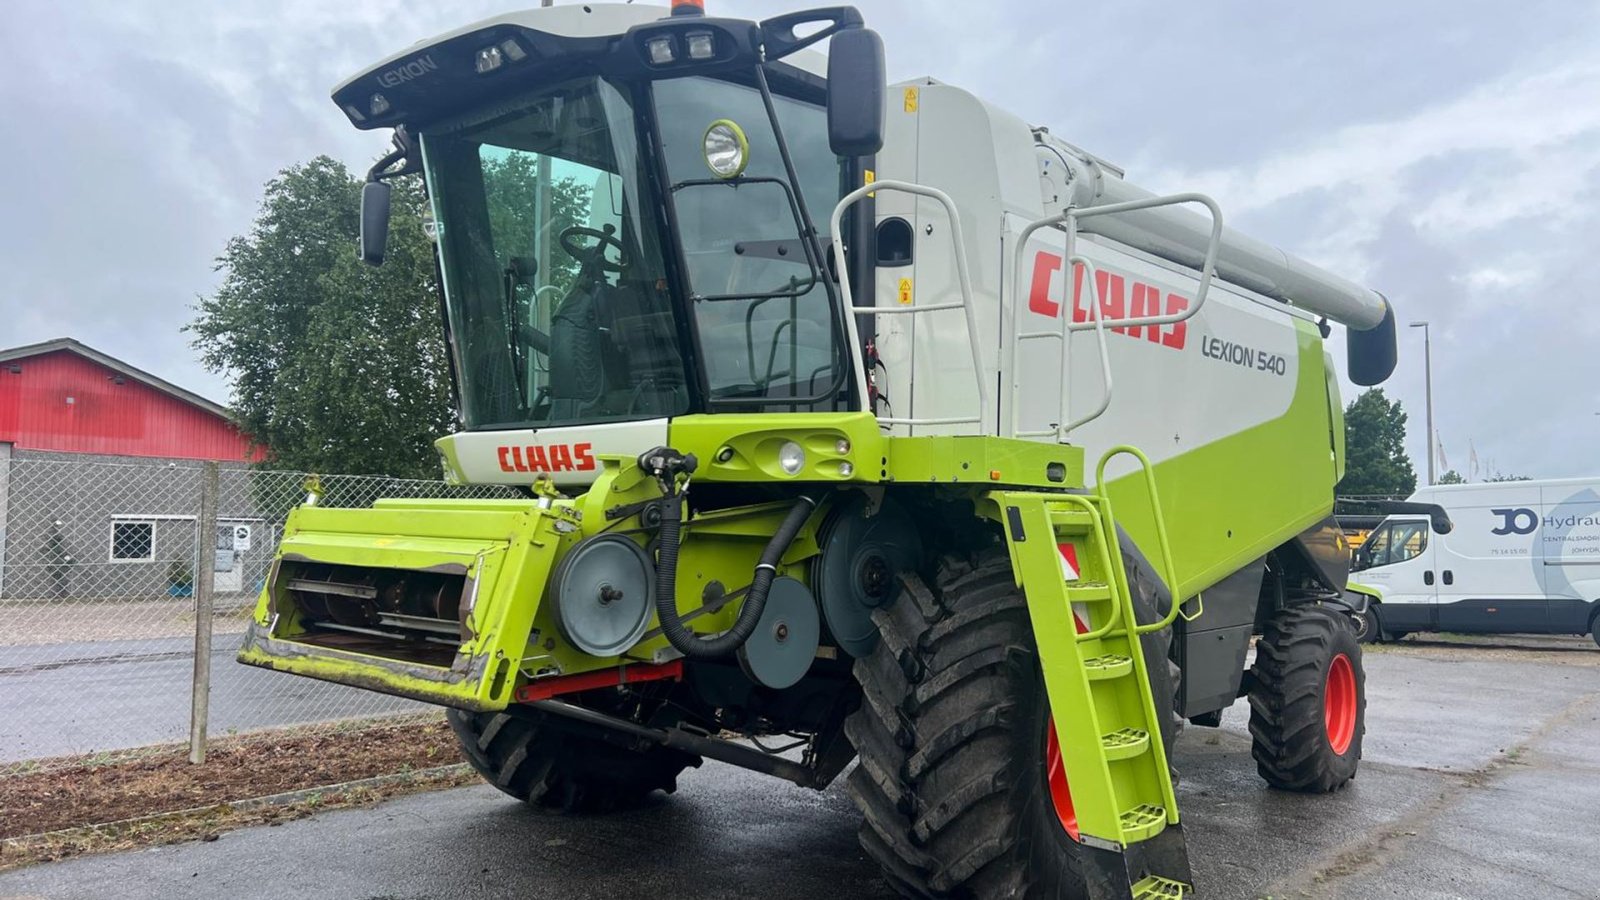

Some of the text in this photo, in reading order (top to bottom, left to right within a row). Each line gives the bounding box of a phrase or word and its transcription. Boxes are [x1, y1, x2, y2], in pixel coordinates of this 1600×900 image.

[376, 54, 438, 88] LEXION
[1029, 250, 1188, 351] CLAAS
[1202, 335, 1286, 376] LEXION 540
[497, 443, 595, 473] CLAAS
[1490, 508, 1538, 535] JO
